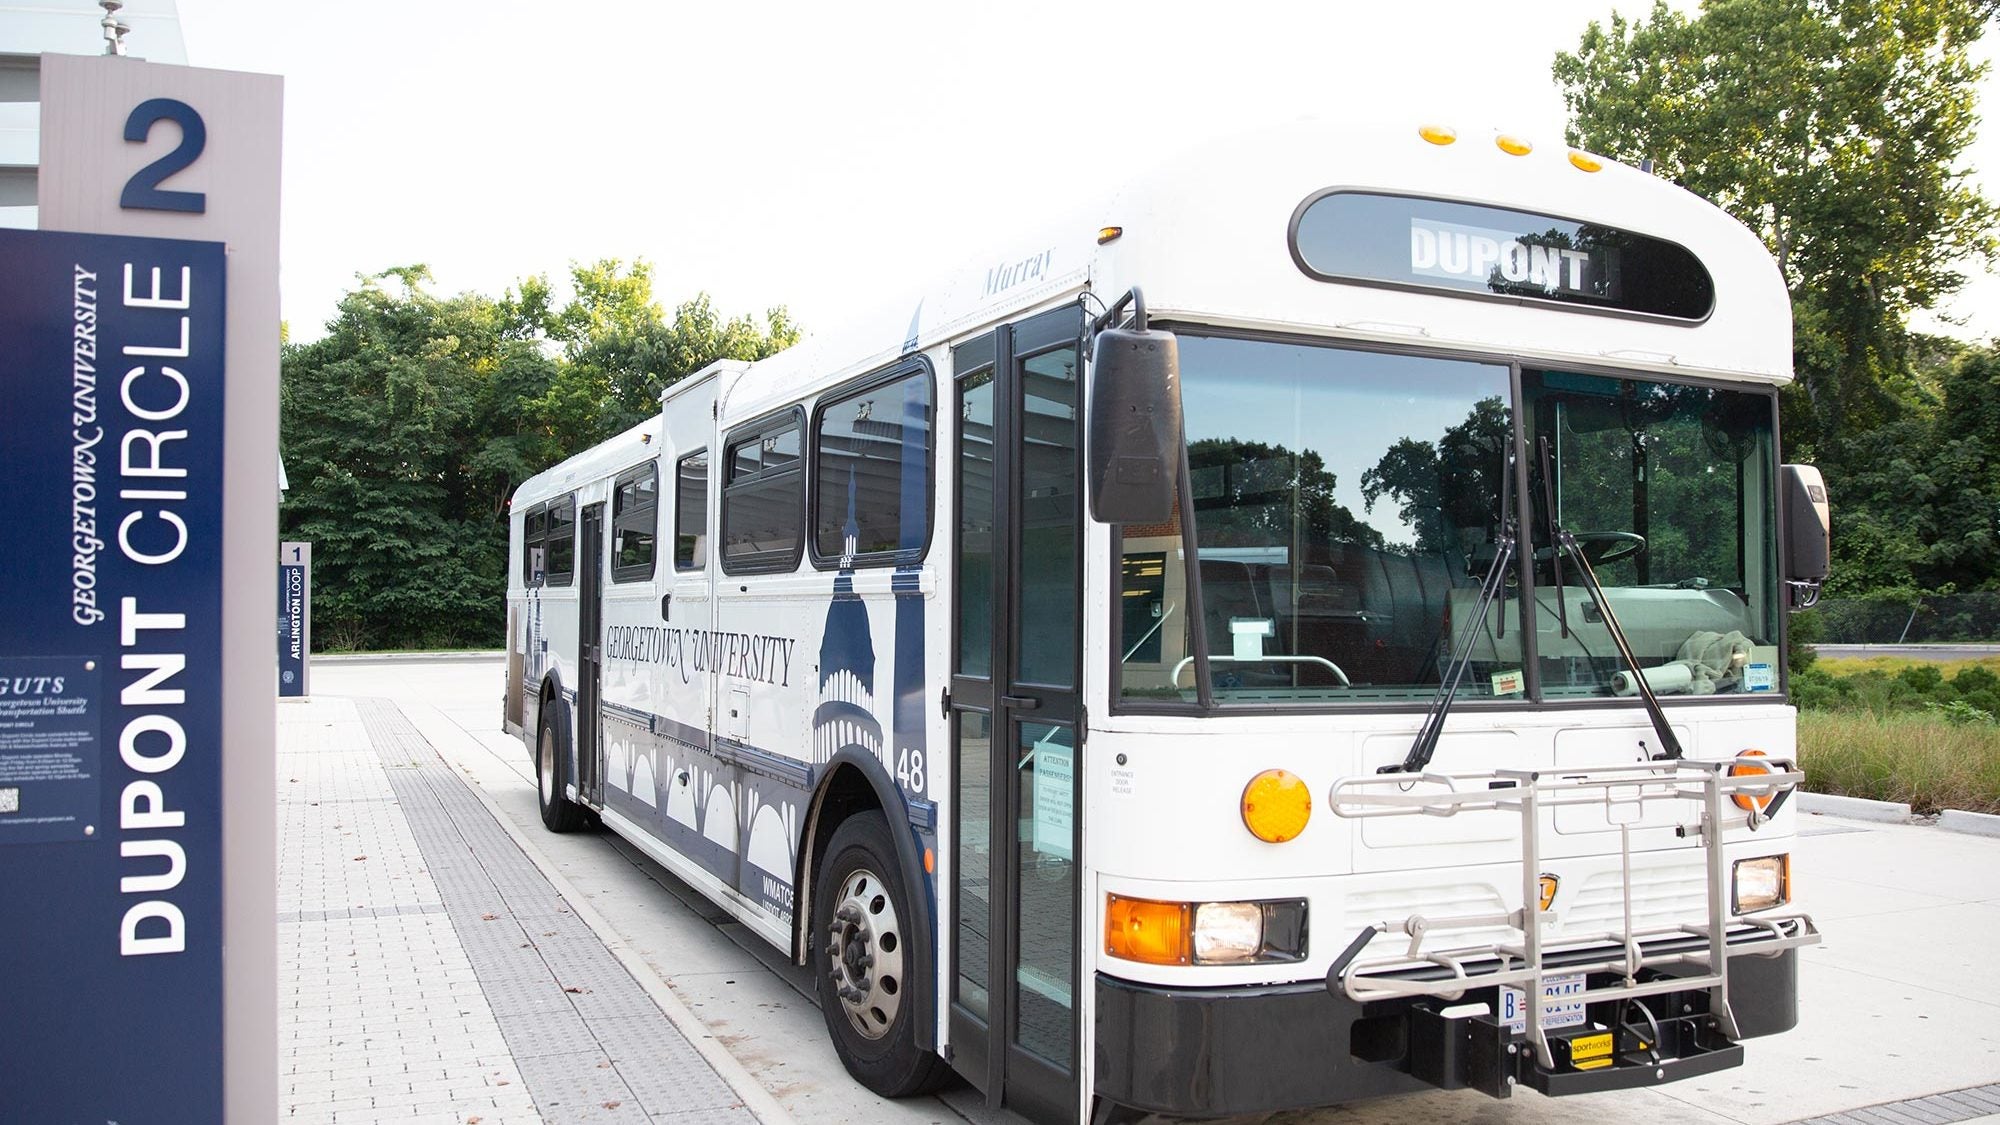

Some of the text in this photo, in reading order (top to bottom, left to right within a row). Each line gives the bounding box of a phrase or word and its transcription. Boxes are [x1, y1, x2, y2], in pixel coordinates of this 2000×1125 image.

[120, 98, 207, 214] 2
[980, 247, 1056, 299] Murray
[1411, 227, 1589, 291] DUPONT
[73, 264, 104, 626] GEORGETOWN UNIVERSITY
[293, 547, 300, 561] 1
[118, 263, 190, 955] DUPONT CIRCLE
[291, 568, 301, 660] ARLINGTON LOOP
[606, 625, 795, 688] GEORGETOWN UNIVERSITY
[897, 748, 924, 793] 48
[1506, 993, 1514, 1019] B
